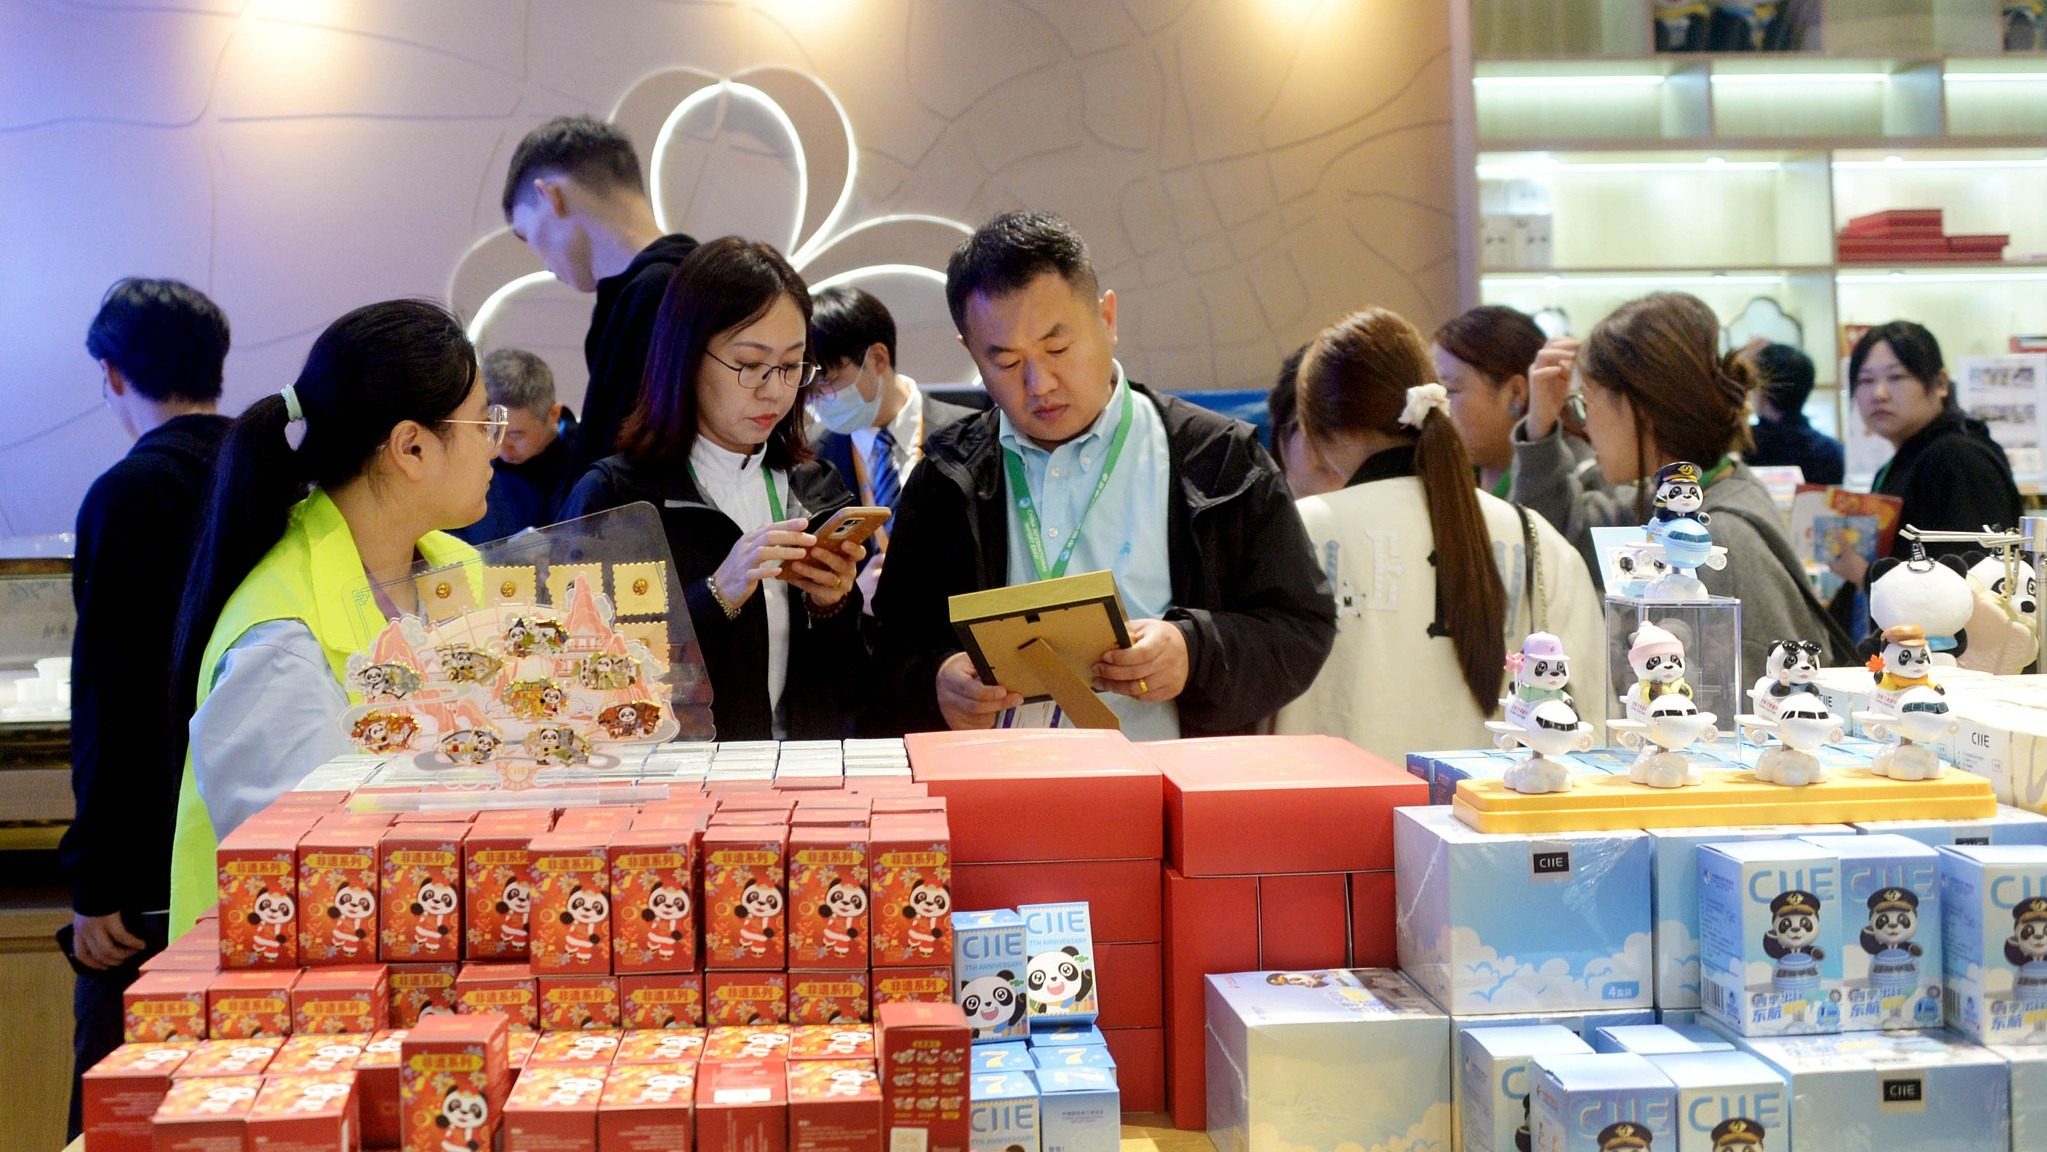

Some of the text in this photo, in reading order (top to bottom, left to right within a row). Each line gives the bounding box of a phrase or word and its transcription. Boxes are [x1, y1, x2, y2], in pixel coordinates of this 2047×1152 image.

[1971, 732, 1990, 749] CIIE
[1539, 857, 1563, 868] CIIE
[1749, 866, 1836, 904] CIIE
[1850, 864, 1935, 902] CIIE
[1026, 911, 1086, 935] CIIE
[962, 932, 1023, 959] CIIE
[1043, 937, 1087, 945] ANNIVERSARY
[979, 961, 1024, 970] ANNIVERSARY
[727, 987, 773, 999] 非遗系列
[807, 983, 853, 995] 非遗系列
[892, 978, 938, 993] 非遗系列
[1889, 1084, 1916, 1097] CIIE
[971, 1104, 1034, 1133] CIIE
[1577, 1096, 1671, 1140] CIIE
[1687, 1092, 1782, 1132] CIIE
